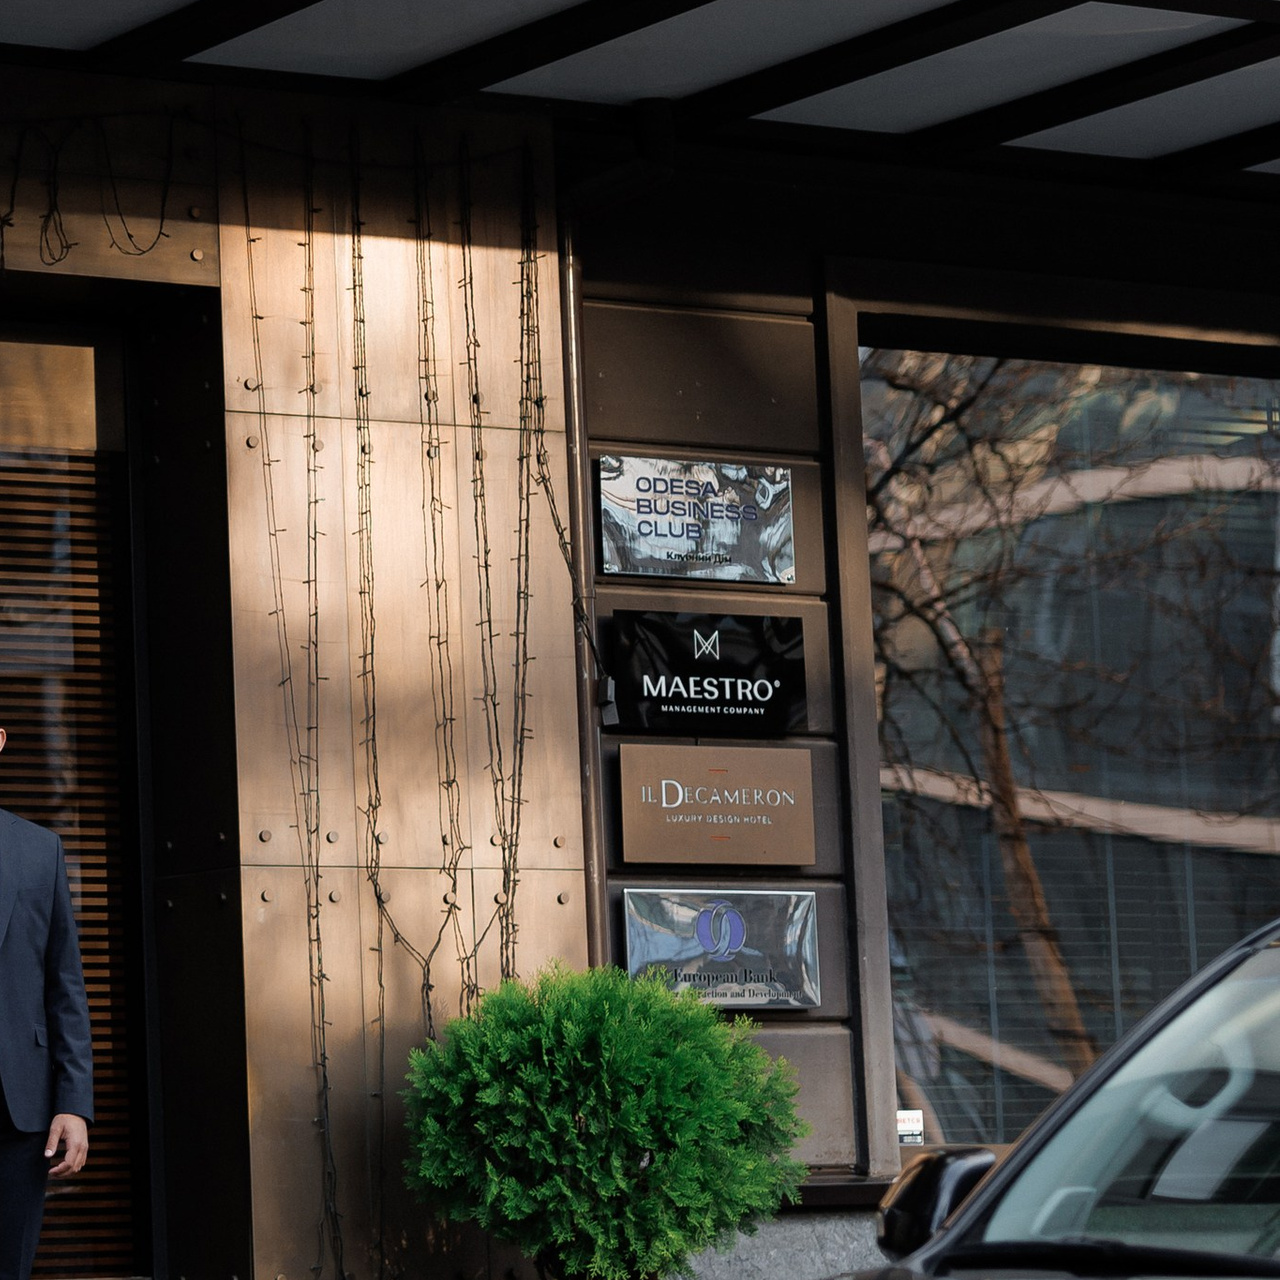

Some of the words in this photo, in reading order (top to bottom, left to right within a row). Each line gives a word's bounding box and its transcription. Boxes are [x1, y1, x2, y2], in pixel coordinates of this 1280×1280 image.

[636, 476, 718, 497] ODESA
[636, 498, 758, 522] BUSINESS
[637, 520, 703, 540] CLUB
[661, 704, 721, 714] MANAGEMENT
[723, 706, 765, 716] COMPANY
[641, 785, 658, 803] IL
[666, 814, 703, 823] LUXURY
[706, 815, 741, 824] DESIGN
[744, 816, 773, 825] HOTEL
[674, 968, 738, 986] European
[744, 969, 778, 984] Bank
[730, 988, 746, 999] and
